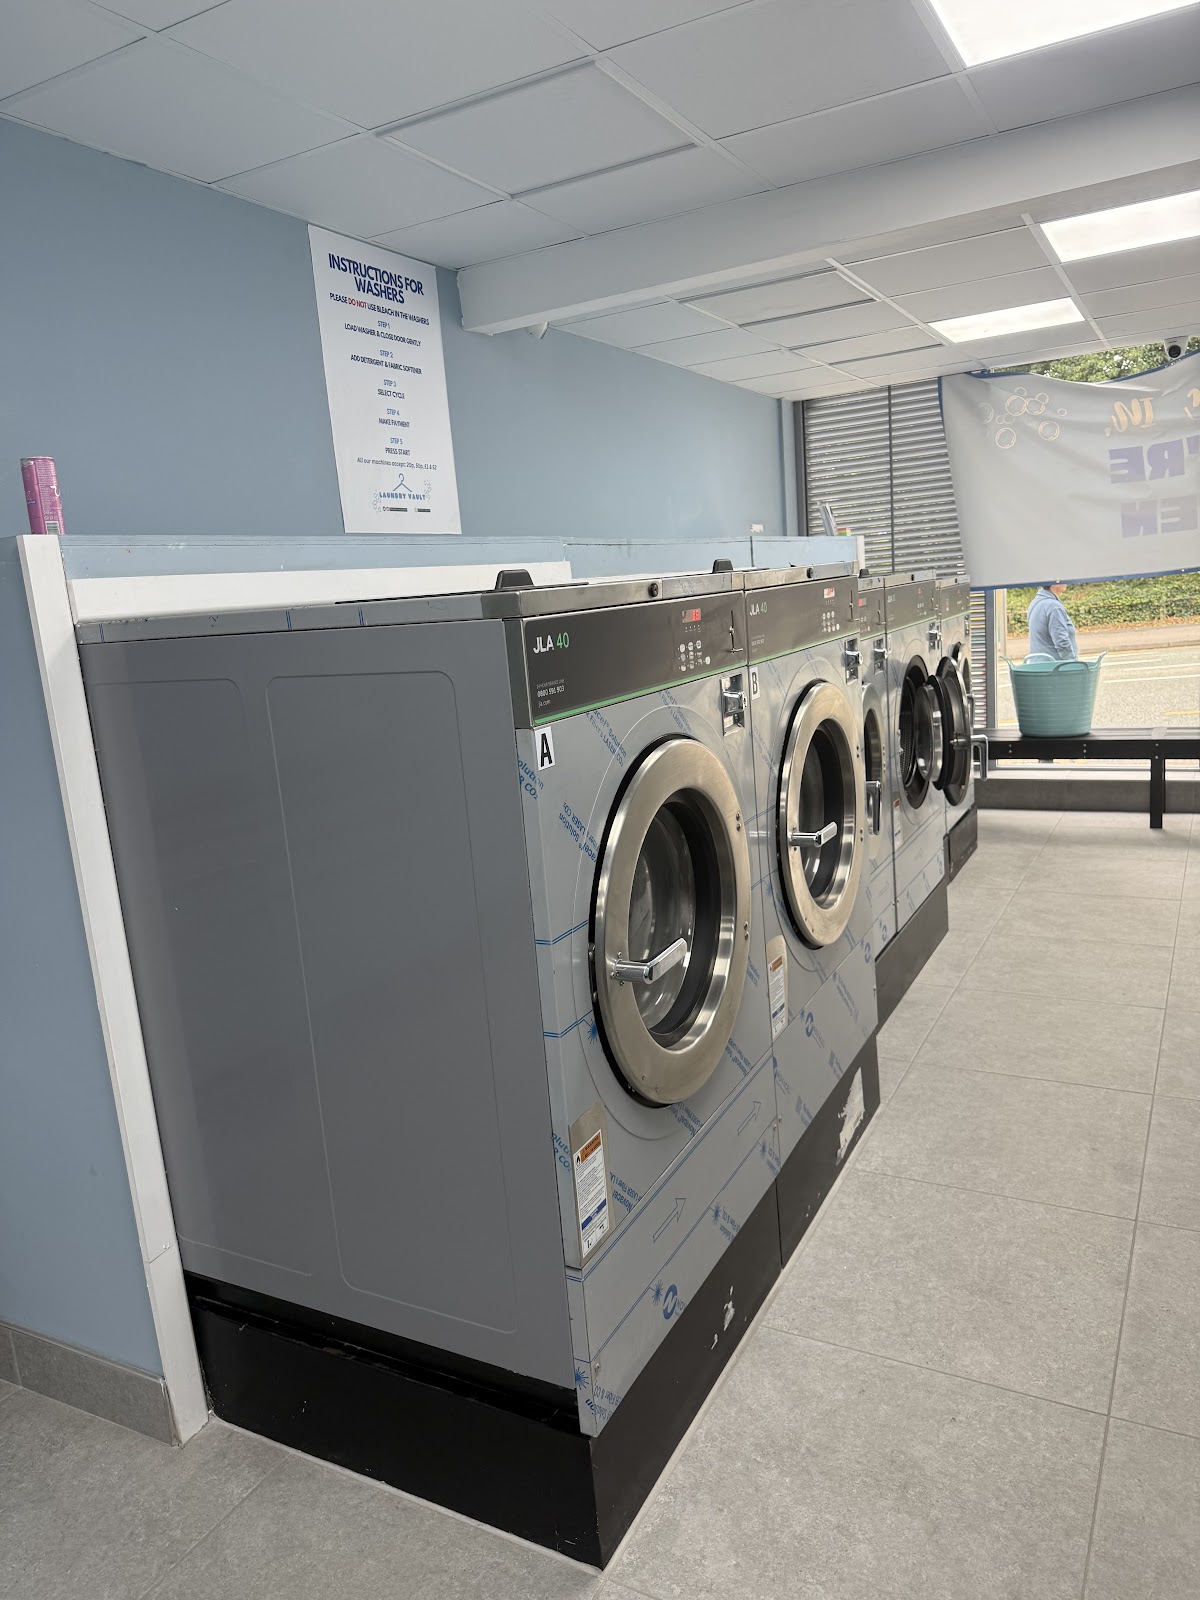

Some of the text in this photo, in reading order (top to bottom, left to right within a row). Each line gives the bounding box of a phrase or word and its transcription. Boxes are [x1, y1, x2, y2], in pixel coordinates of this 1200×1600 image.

[328, 252, 424, 296] INSTRUCTIONS FOR
[354, 276, 405, 304] WASHERS
[329, 292, 348, 304] PLEASE
[348, 297, 356, 306] DO
[356, 299, 367, 309] NOT
[367, 302, 376, 312] USE
[376, 305, 395, 317] BLEACH
[399, 311, 408, 320] THE
[408, 313, 430, 326] WASHERS
[344, 322, 357, 332] LOAD
[357, 325, 376, 337] WASHER
[380, 331, 394, 341] CLOSE
[394, 334, 406, 343] DOOR
[406, 337, 422, 347] GENTLY
[377, 320, 388, 329] STEP
[379, 349, 390, 358] STEP
[350, 354, 361, 362] ADD
[360, 356, 384, 367] DETERGENT
[388, 361, 403, 371] FABRIC
[402, 365, 423, 375] SOFTENER
[383, 378, 393, 387] STEP
[377, 388, 406, 400] SELECT CYCLE
[386, 408, 396, 416] STEP
[385, 447, 411, 456] PRESS START
[390, 437, 399, 445] STEP
[378, 491, 426, 501] LAUNDRY VAULT
[749, 601, 768, 617] JLA 40
[533, 631, 570, 654] JLA 40
[751, 671, 759, 696] B
[540, 733, 553, 768] A
[602, 734, 616, 755] LASER
[571, 813, 586, 835] LASER
